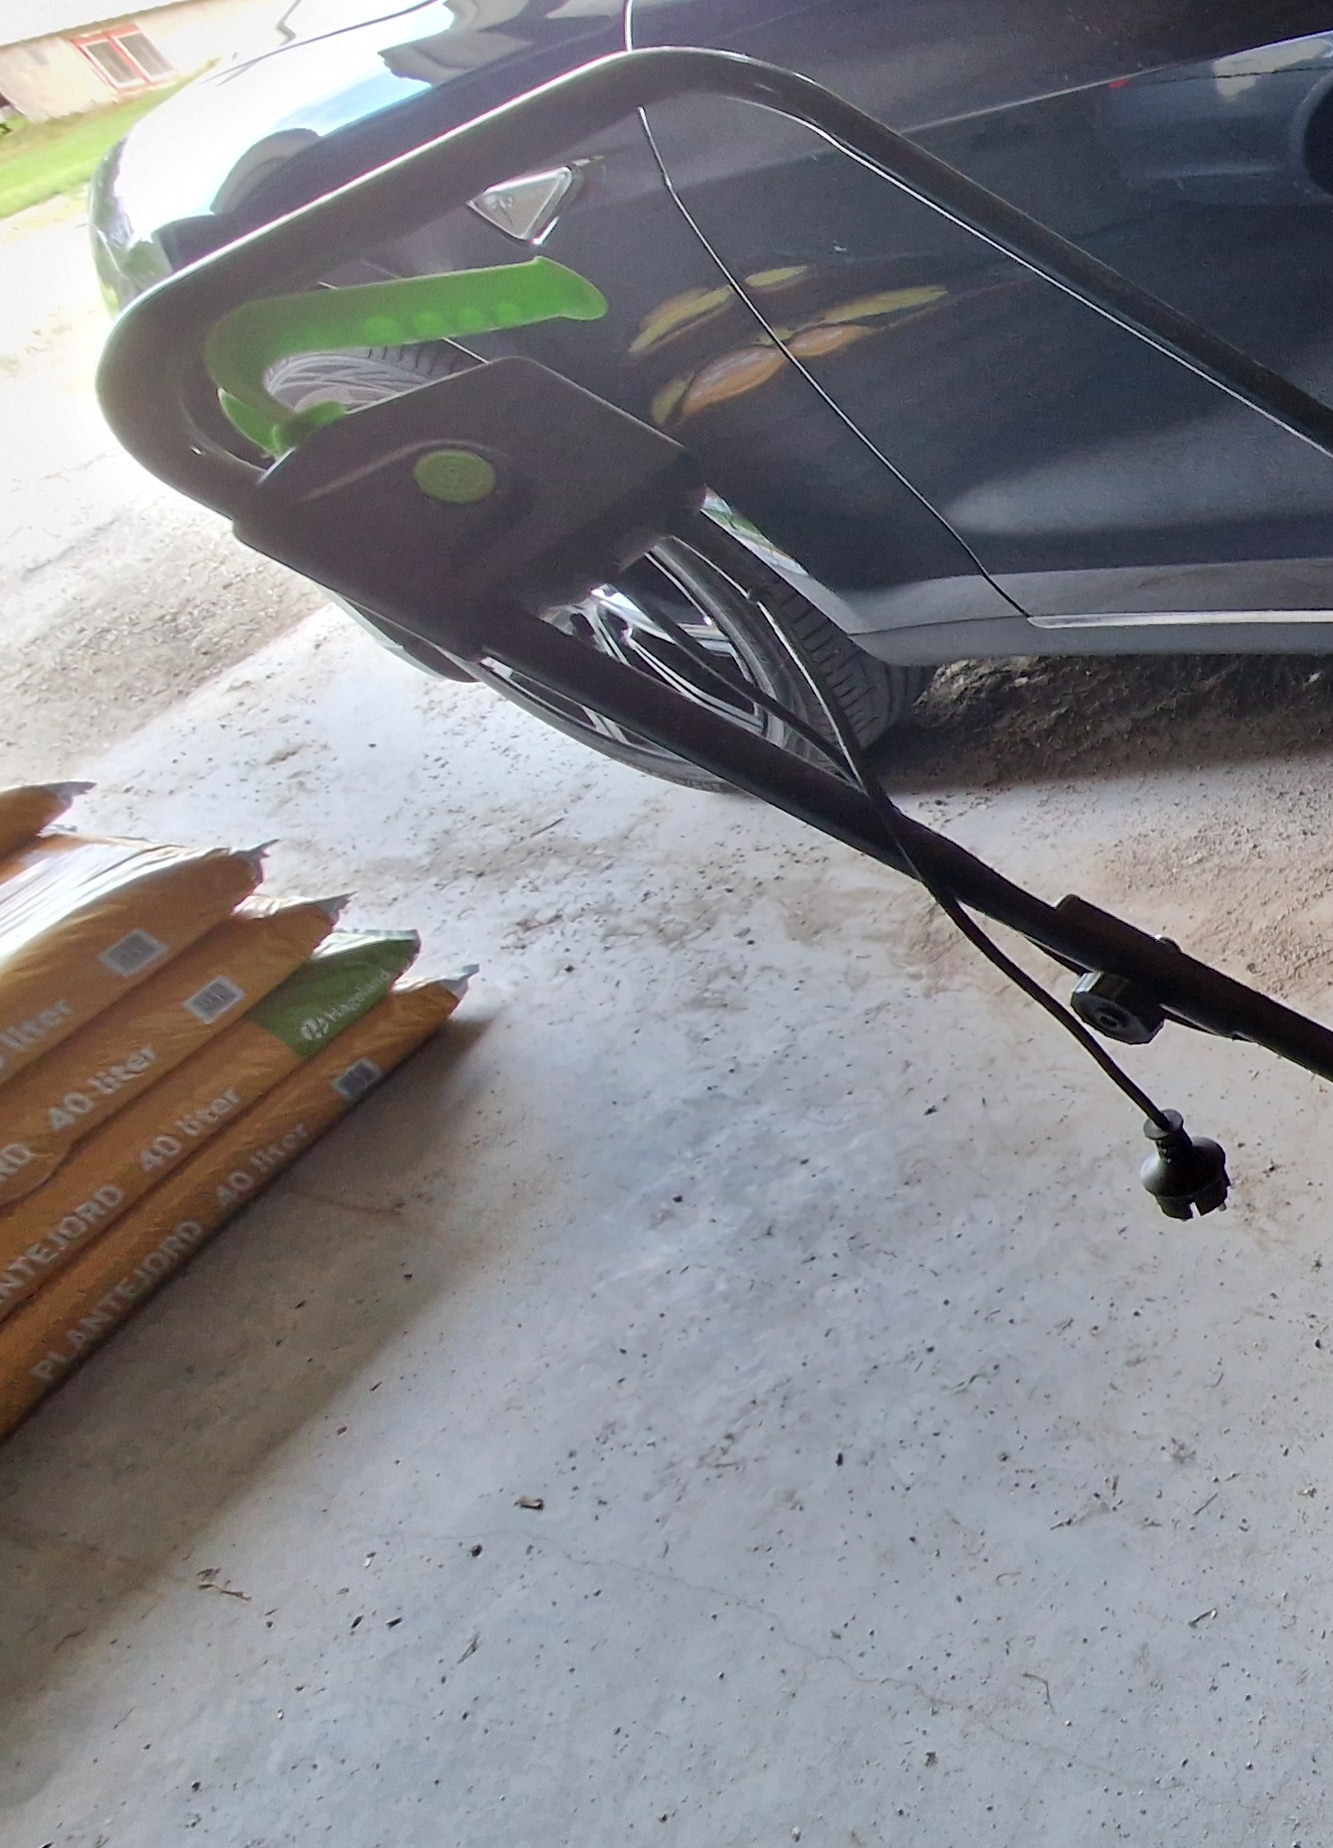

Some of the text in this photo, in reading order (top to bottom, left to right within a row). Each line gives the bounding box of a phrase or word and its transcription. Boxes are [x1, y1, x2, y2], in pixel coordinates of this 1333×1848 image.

[0, 1088, 240, 1298] NTEJORD 40 liter
[48, 1092, 96, 1131] 40
[86, 1045, 156, 1094] liter
[29, 1123, 307, 1379] PLANTEJORD 40 liter
